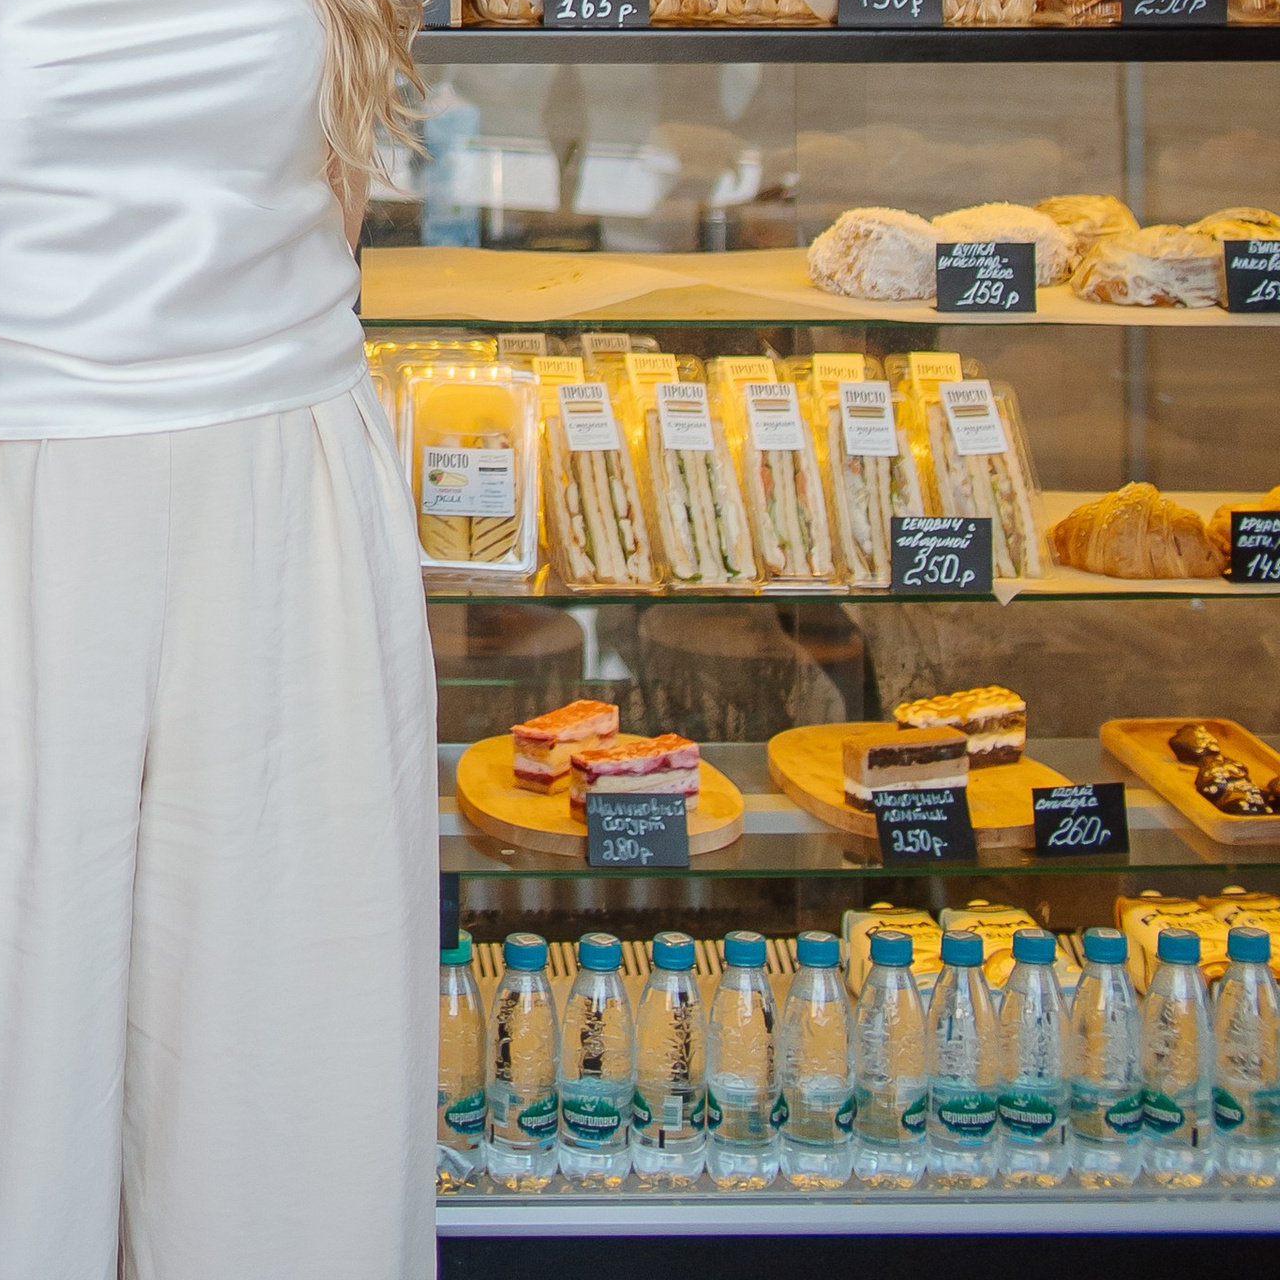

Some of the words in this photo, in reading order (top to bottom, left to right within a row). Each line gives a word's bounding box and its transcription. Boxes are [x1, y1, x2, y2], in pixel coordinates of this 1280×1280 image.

[1248, 240, 1280, 254] БУЛК
[1245, 279, 1280, 303] 15
[562, 385, 603, 399] ПРОСТО
[662, 385, 704, 399] ПРОСТО
[749, 384, 791, 397] ПРОСТО
[845, 391, 886, 404] ПРОСТО
[947, 390, 988, 403] ПРОСТО
[428, 452, 469, 468] ПРОСТО
[1239, 517, 1280, 532] КРУАС
